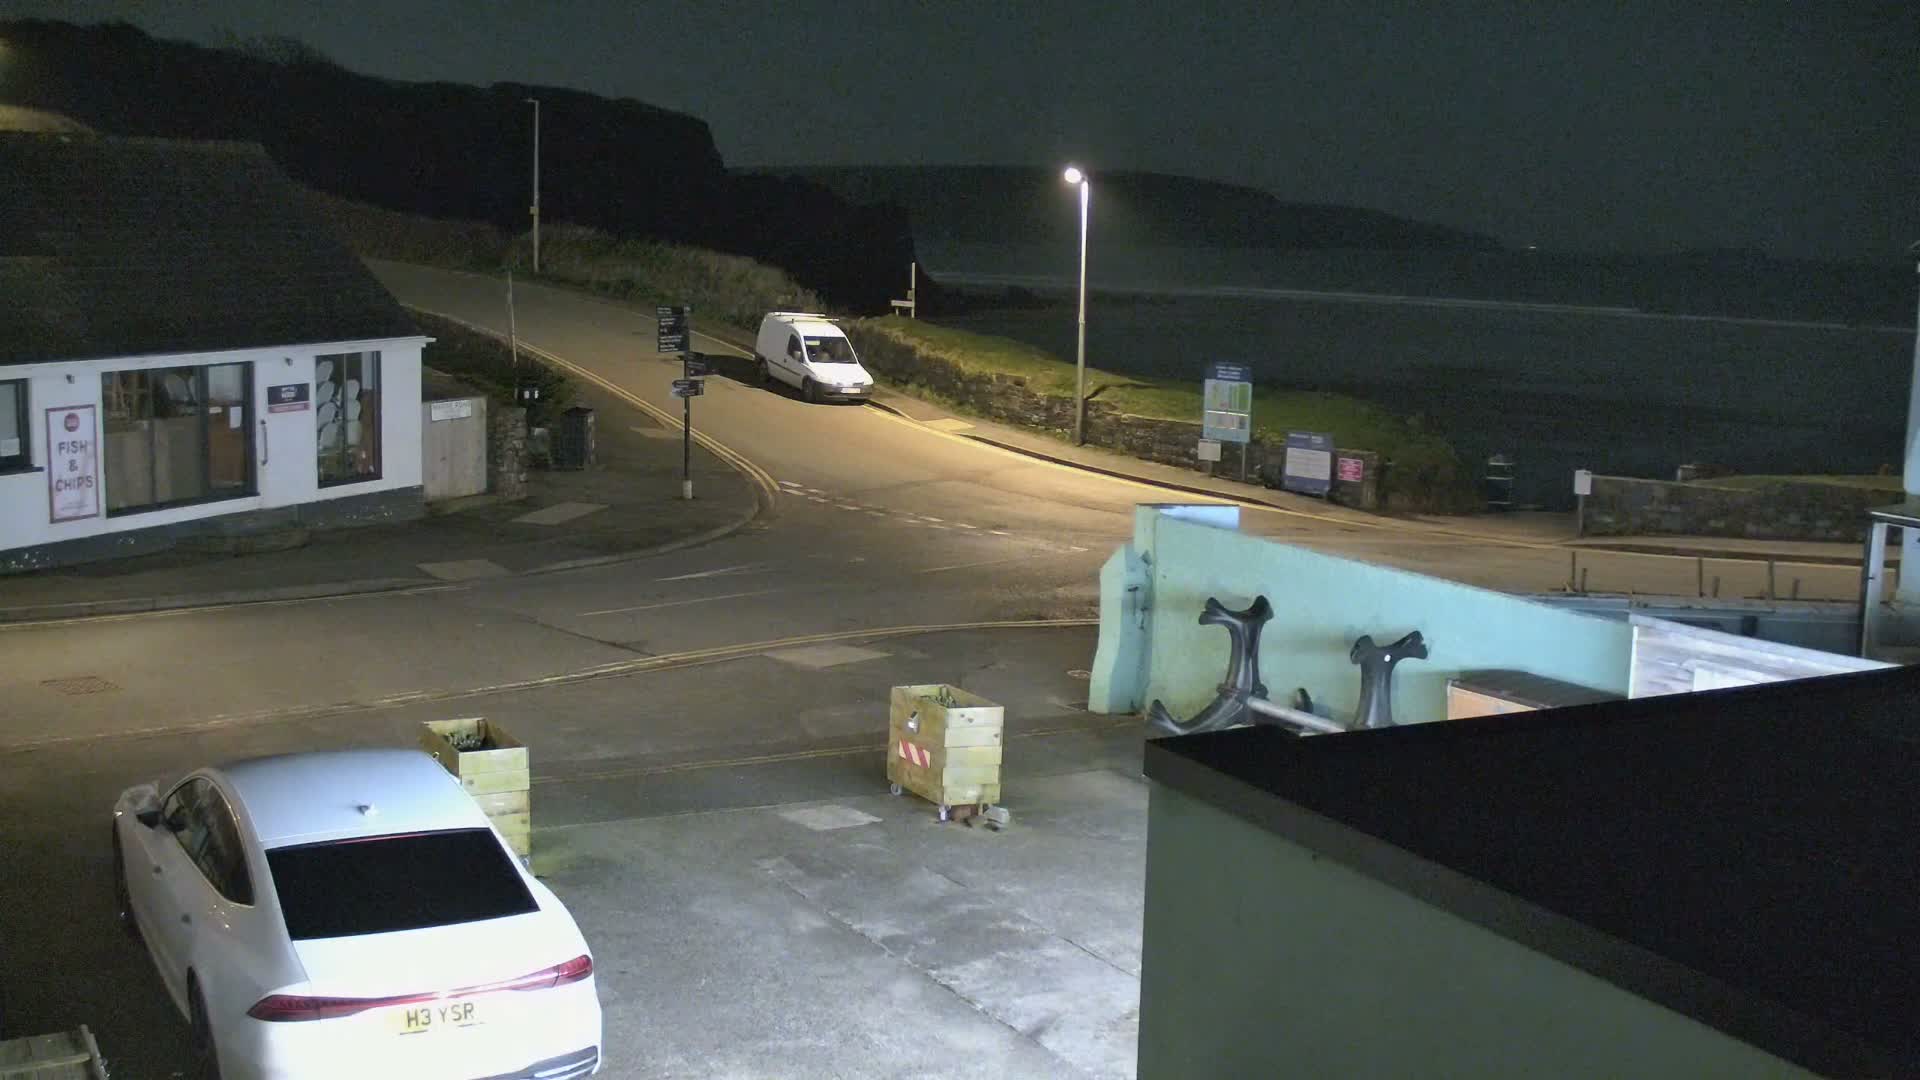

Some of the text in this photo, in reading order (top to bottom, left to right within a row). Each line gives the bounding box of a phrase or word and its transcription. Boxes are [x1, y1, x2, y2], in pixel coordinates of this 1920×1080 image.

[58, 440, 87, 455] FISH
[69, 459, 78, 472] &
[55, 476, 93, 492] CHIPS
[407, 1002, 474, 1028] H3 YSR
